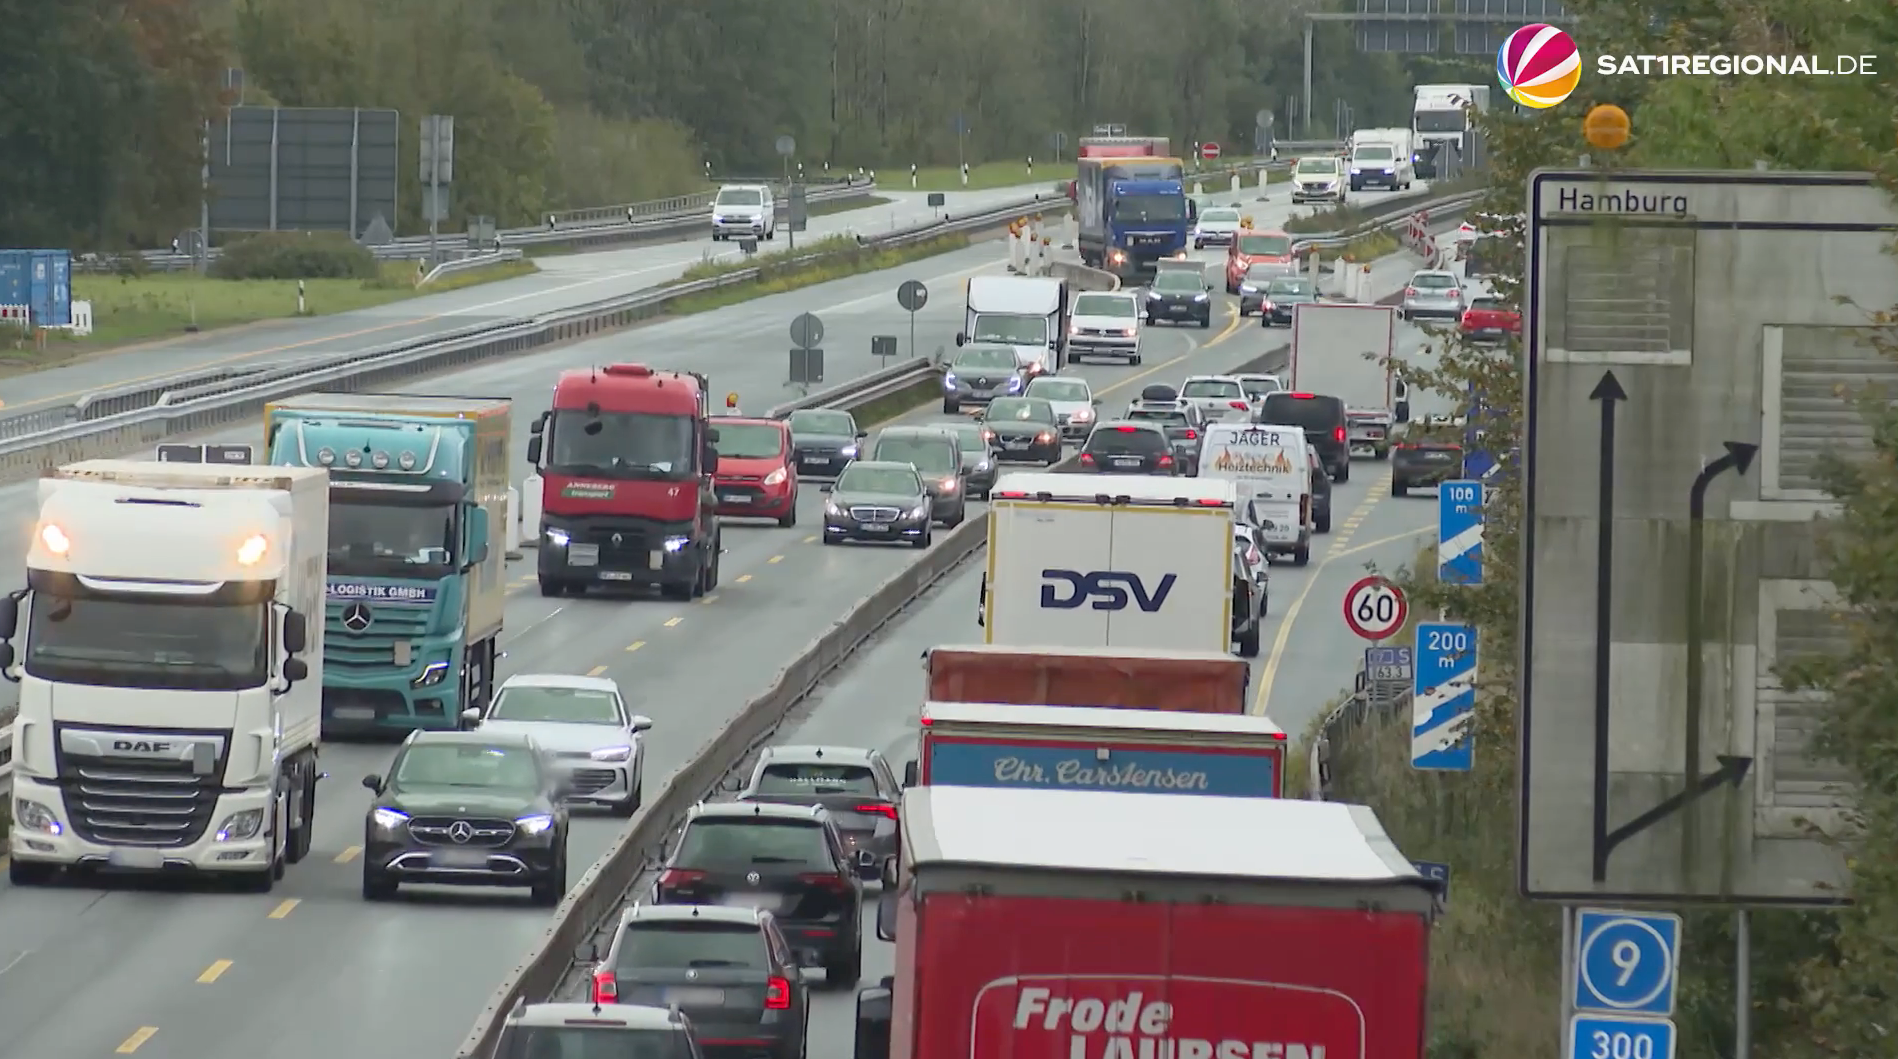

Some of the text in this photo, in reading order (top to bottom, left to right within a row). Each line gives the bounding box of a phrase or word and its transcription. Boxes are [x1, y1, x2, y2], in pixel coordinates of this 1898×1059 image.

[1559, 187, 1688, 220] Hamburg
[1218, 462, 1291, 475] Heiztechnik
[667, 487, 680, 497] 47
[1449, 487, 1474, 502] 100
[1455, 504, 1467, 514] m
[1040, 569, 1178, 612] DSV
[1357, 593, 1393, 622] 60
[1428, 631, 1467, 651] 200
[1439, 656, 1454, 668] m
[113, 741, 170, 752] DAF
[994, 756, 1209, 790] Chr. Carstensen
[1612, 939, 1641, 987] 9
[1013, 987, 1174, 1035] Frode
[1590, 1030, 1654, 1059] 300
